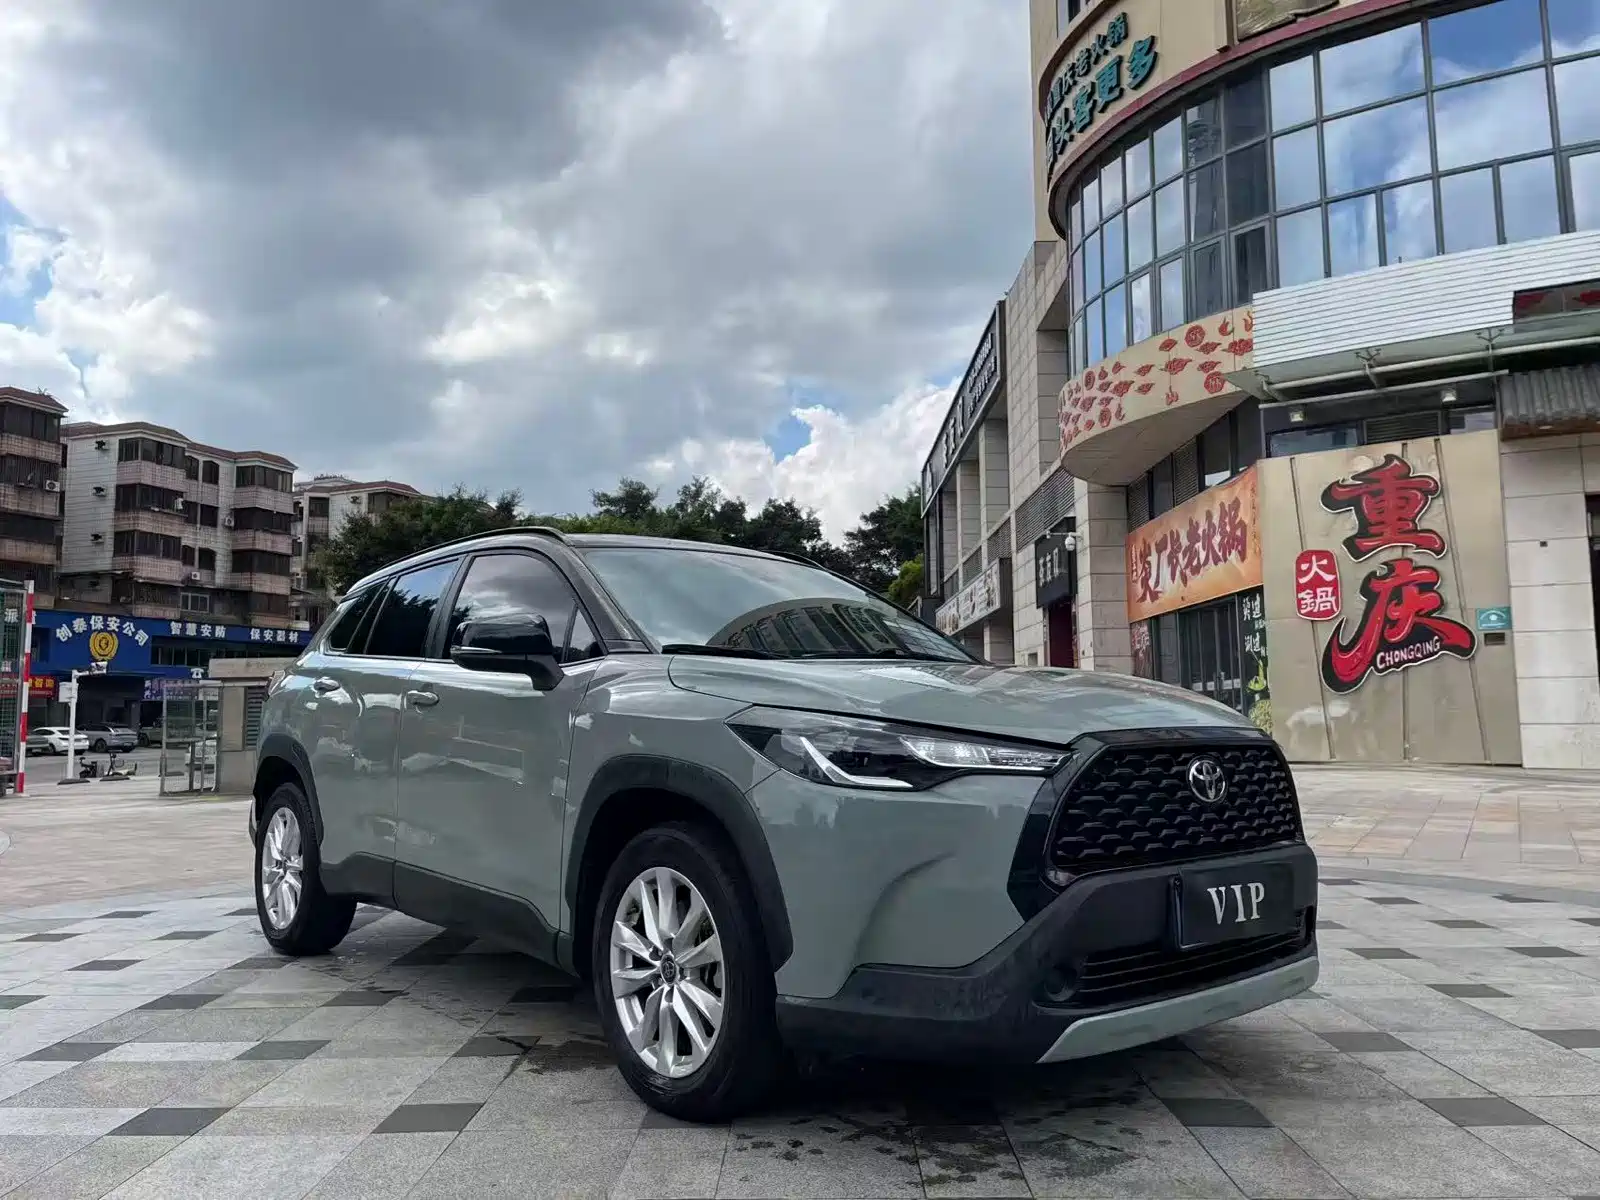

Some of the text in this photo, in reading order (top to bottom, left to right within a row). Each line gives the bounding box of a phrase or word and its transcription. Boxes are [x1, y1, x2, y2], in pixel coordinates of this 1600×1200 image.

[1298, 554, 1337, 614] 火鍋
[1322, 454, 1476, 692] 重庆
[55, 615, 149, 647] 创泰保安公司
[170, 621, 227, 638] 智慧安防
[250, 627, 299, 643] 保安器材
[1376, 636, 1440, 669] CHONGQING
[1207, 882, 1265, 925] VIP
